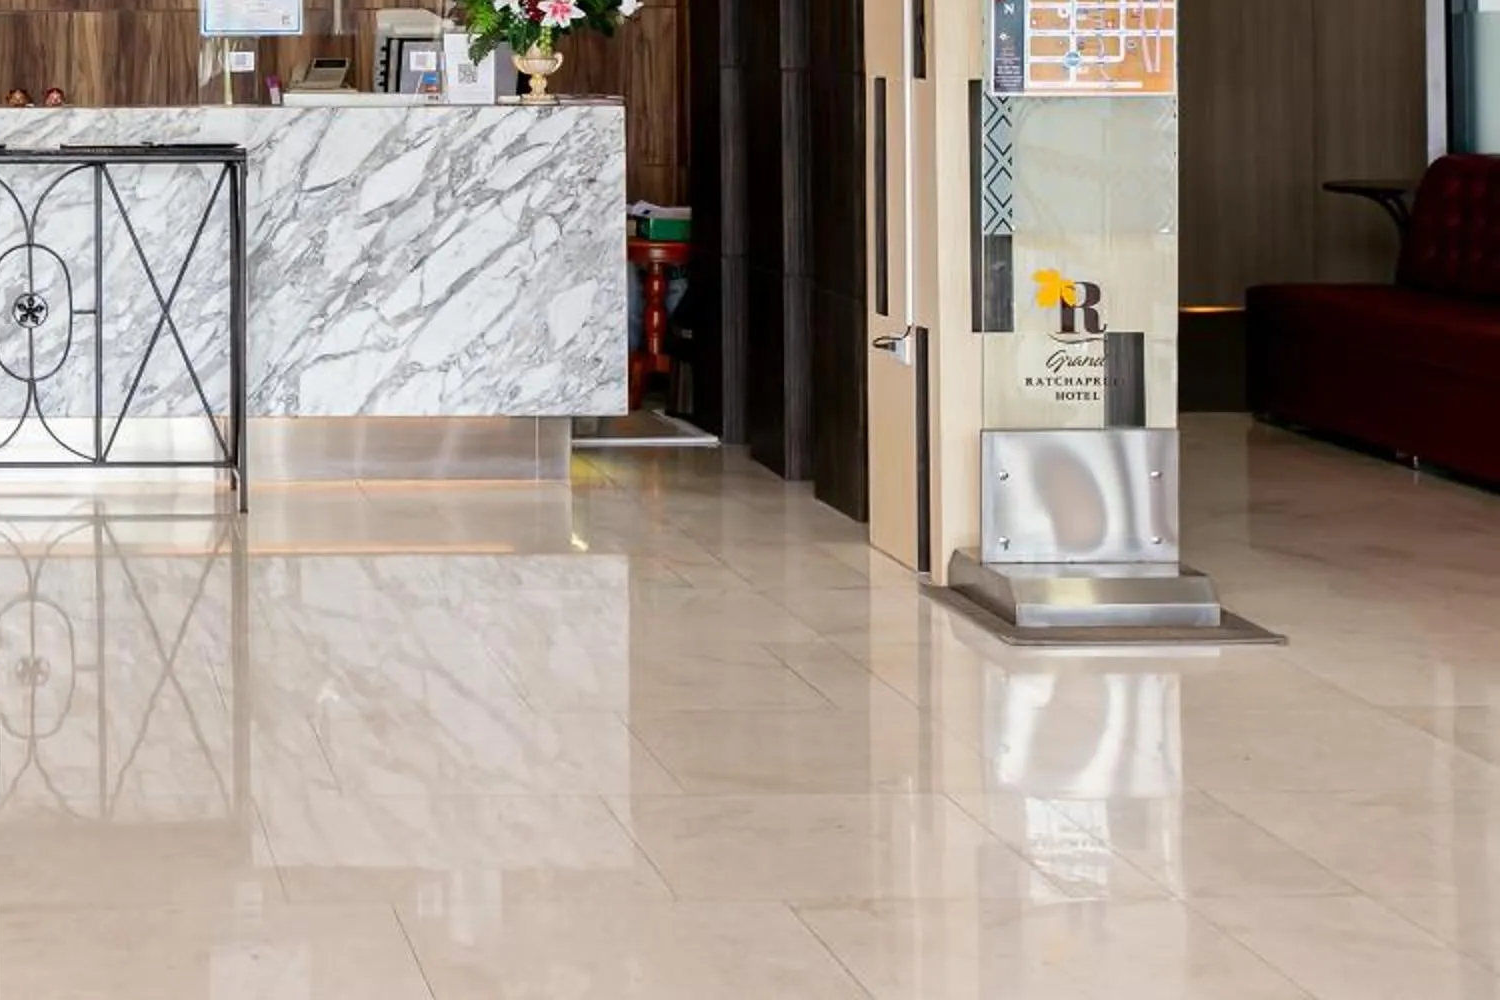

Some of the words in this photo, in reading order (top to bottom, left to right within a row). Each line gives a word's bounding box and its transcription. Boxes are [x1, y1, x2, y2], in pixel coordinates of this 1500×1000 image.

[1056, 281, 1108, 335] R
[1025, 377, 1128, 387] RATCHAPR
[1055, 391, 1101, 401] HOTEL
